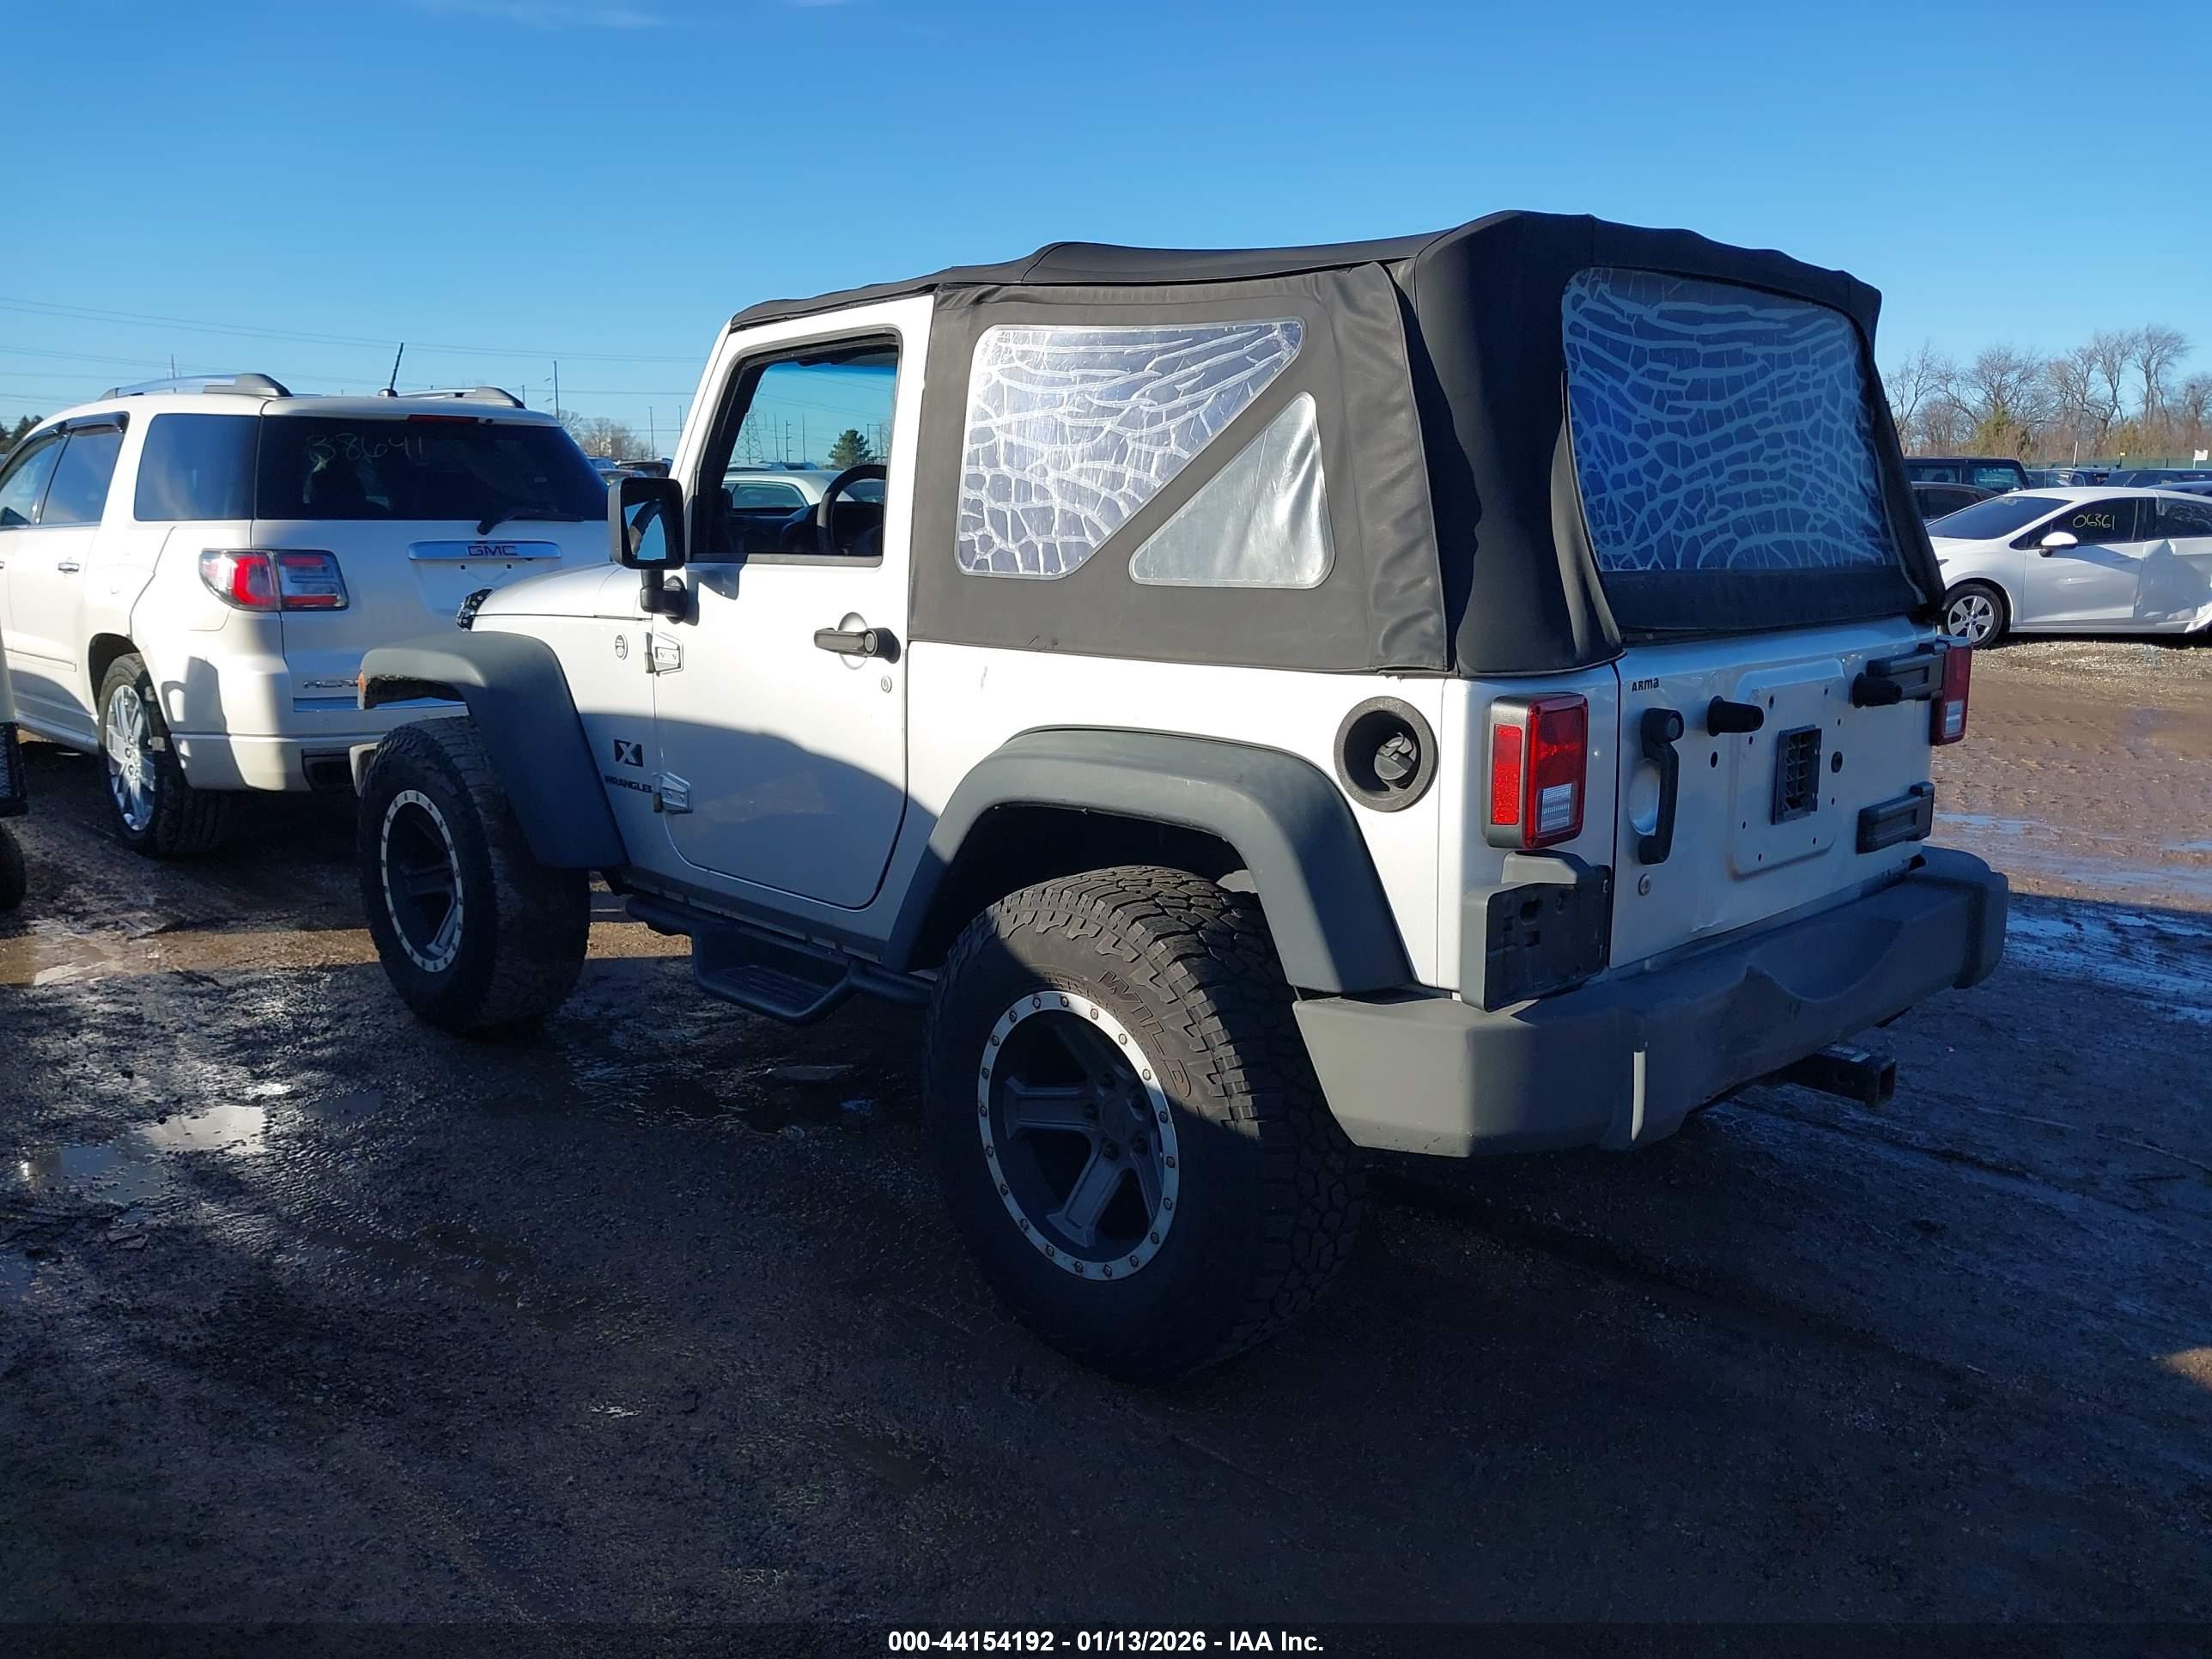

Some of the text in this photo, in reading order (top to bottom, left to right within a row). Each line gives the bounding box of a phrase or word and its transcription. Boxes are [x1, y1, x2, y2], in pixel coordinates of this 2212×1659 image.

[306, 433, 425, 461] 38641
[2073, 514, 2116, 530] 06361
[468, 545, 518, 556] GMC
[1097, 969, 1194, 1099] WILD
